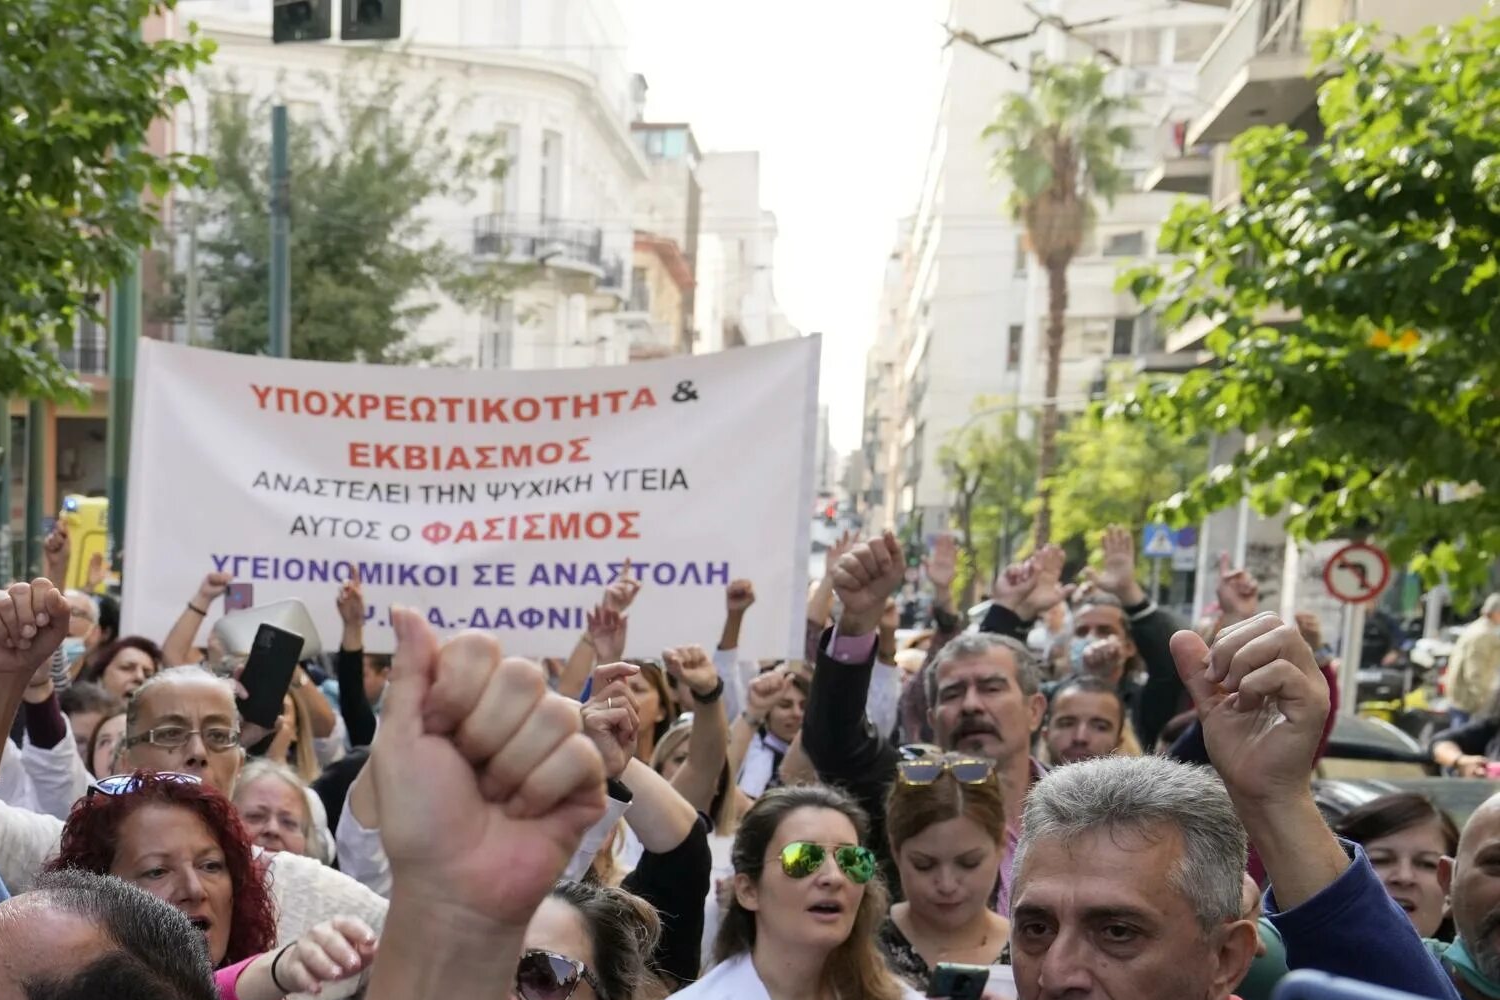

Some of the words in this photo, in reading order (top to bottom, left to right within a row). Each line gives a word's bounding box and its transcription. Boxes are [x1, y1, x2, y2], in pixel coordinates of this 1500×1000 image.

[250, 384, 657, 424] ΥΠΟΧΡΕΩΤΙΚΟΤΗΤΑ
[671, 380, 699, 403] &
[348, 437, 592, 471] ΕΚΒΙΑΣΜΟΣ
[252, 470, 410, 504] ΑΝΑΣΤΕΛΕΙ
[420, 483, 476, 504] ΤΗΝ
[486, 473, 593, 503] ΨΥΧΙΚΗ
[603, 468, 689, 491] ΥΓΕΙΑ
[289, 515, 381, 542] ΑΥΤΟΣ
[391, 523, 412, 543] Ο
[420, 511, 642, 545] ΦΑΣΙΣΜΟΣ
[211, 553, 459, 587] ΥΓΕΙΟΝΟΜΙΚΟΙ
[472, 563, 515, 586] ΣΕ
[528, 561, 730, 586] ΑΝΑΣΤΟΛΗ
